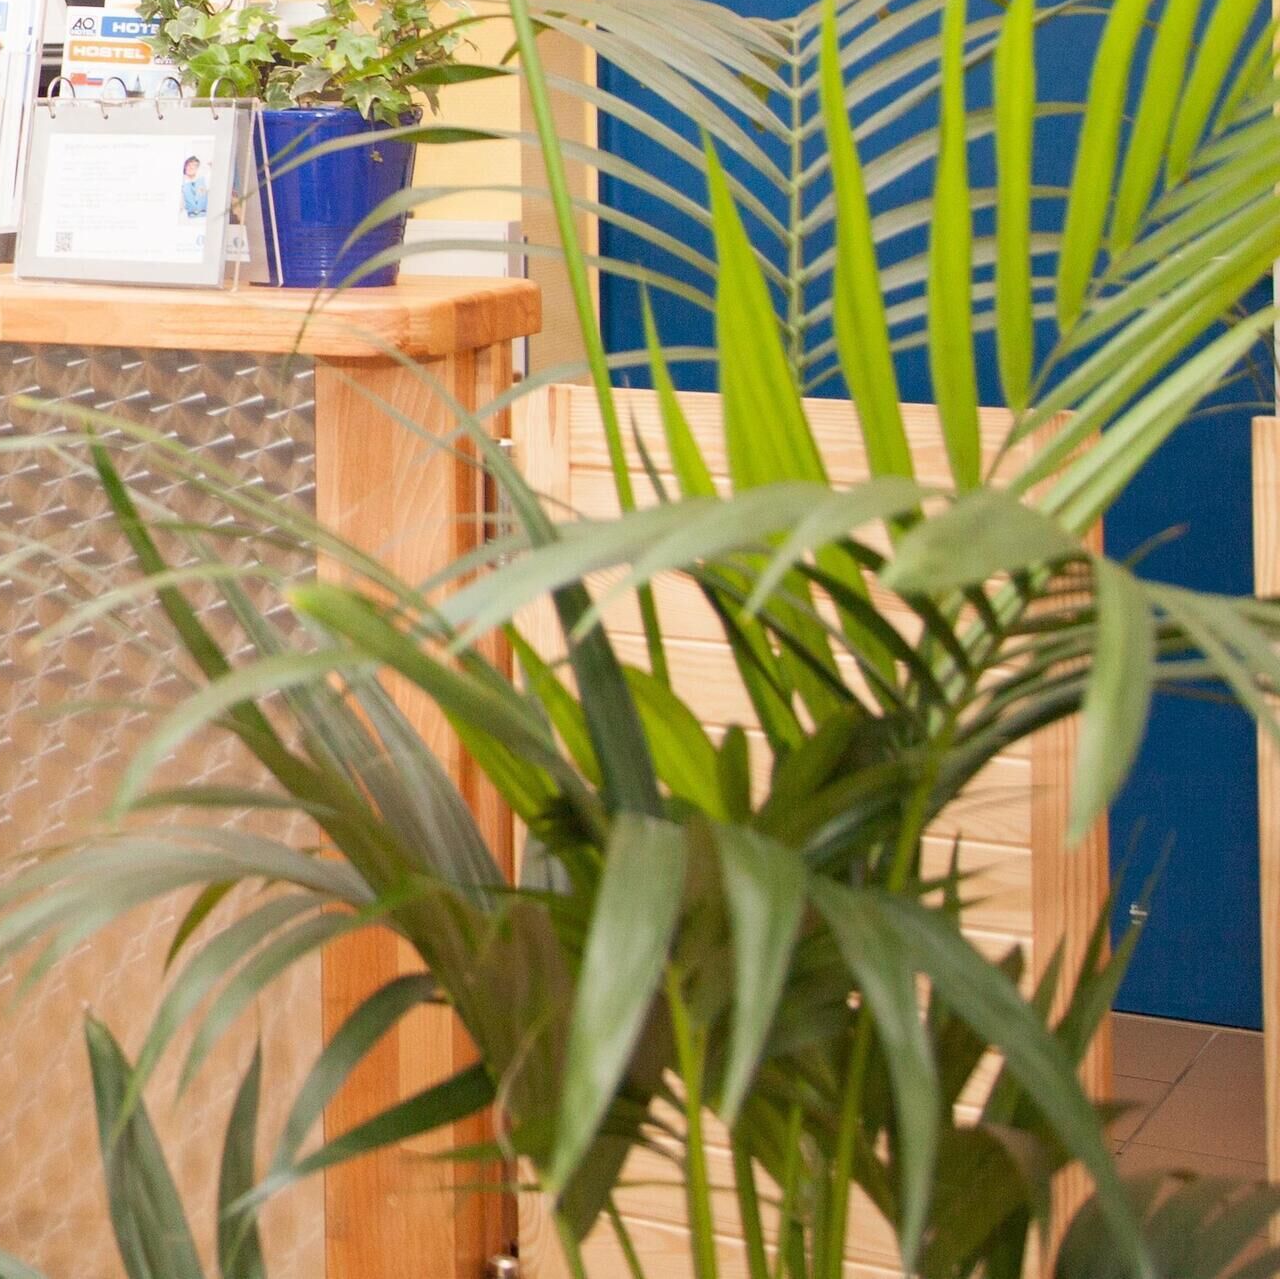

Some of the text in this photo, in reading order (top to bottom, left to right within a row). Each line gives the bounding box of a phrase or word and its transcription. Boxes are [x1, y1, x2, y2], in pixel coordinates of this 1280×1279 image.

[72, 17, 160, 34] AO HOTE
[73, 45, 145, 59] HOSTEL
